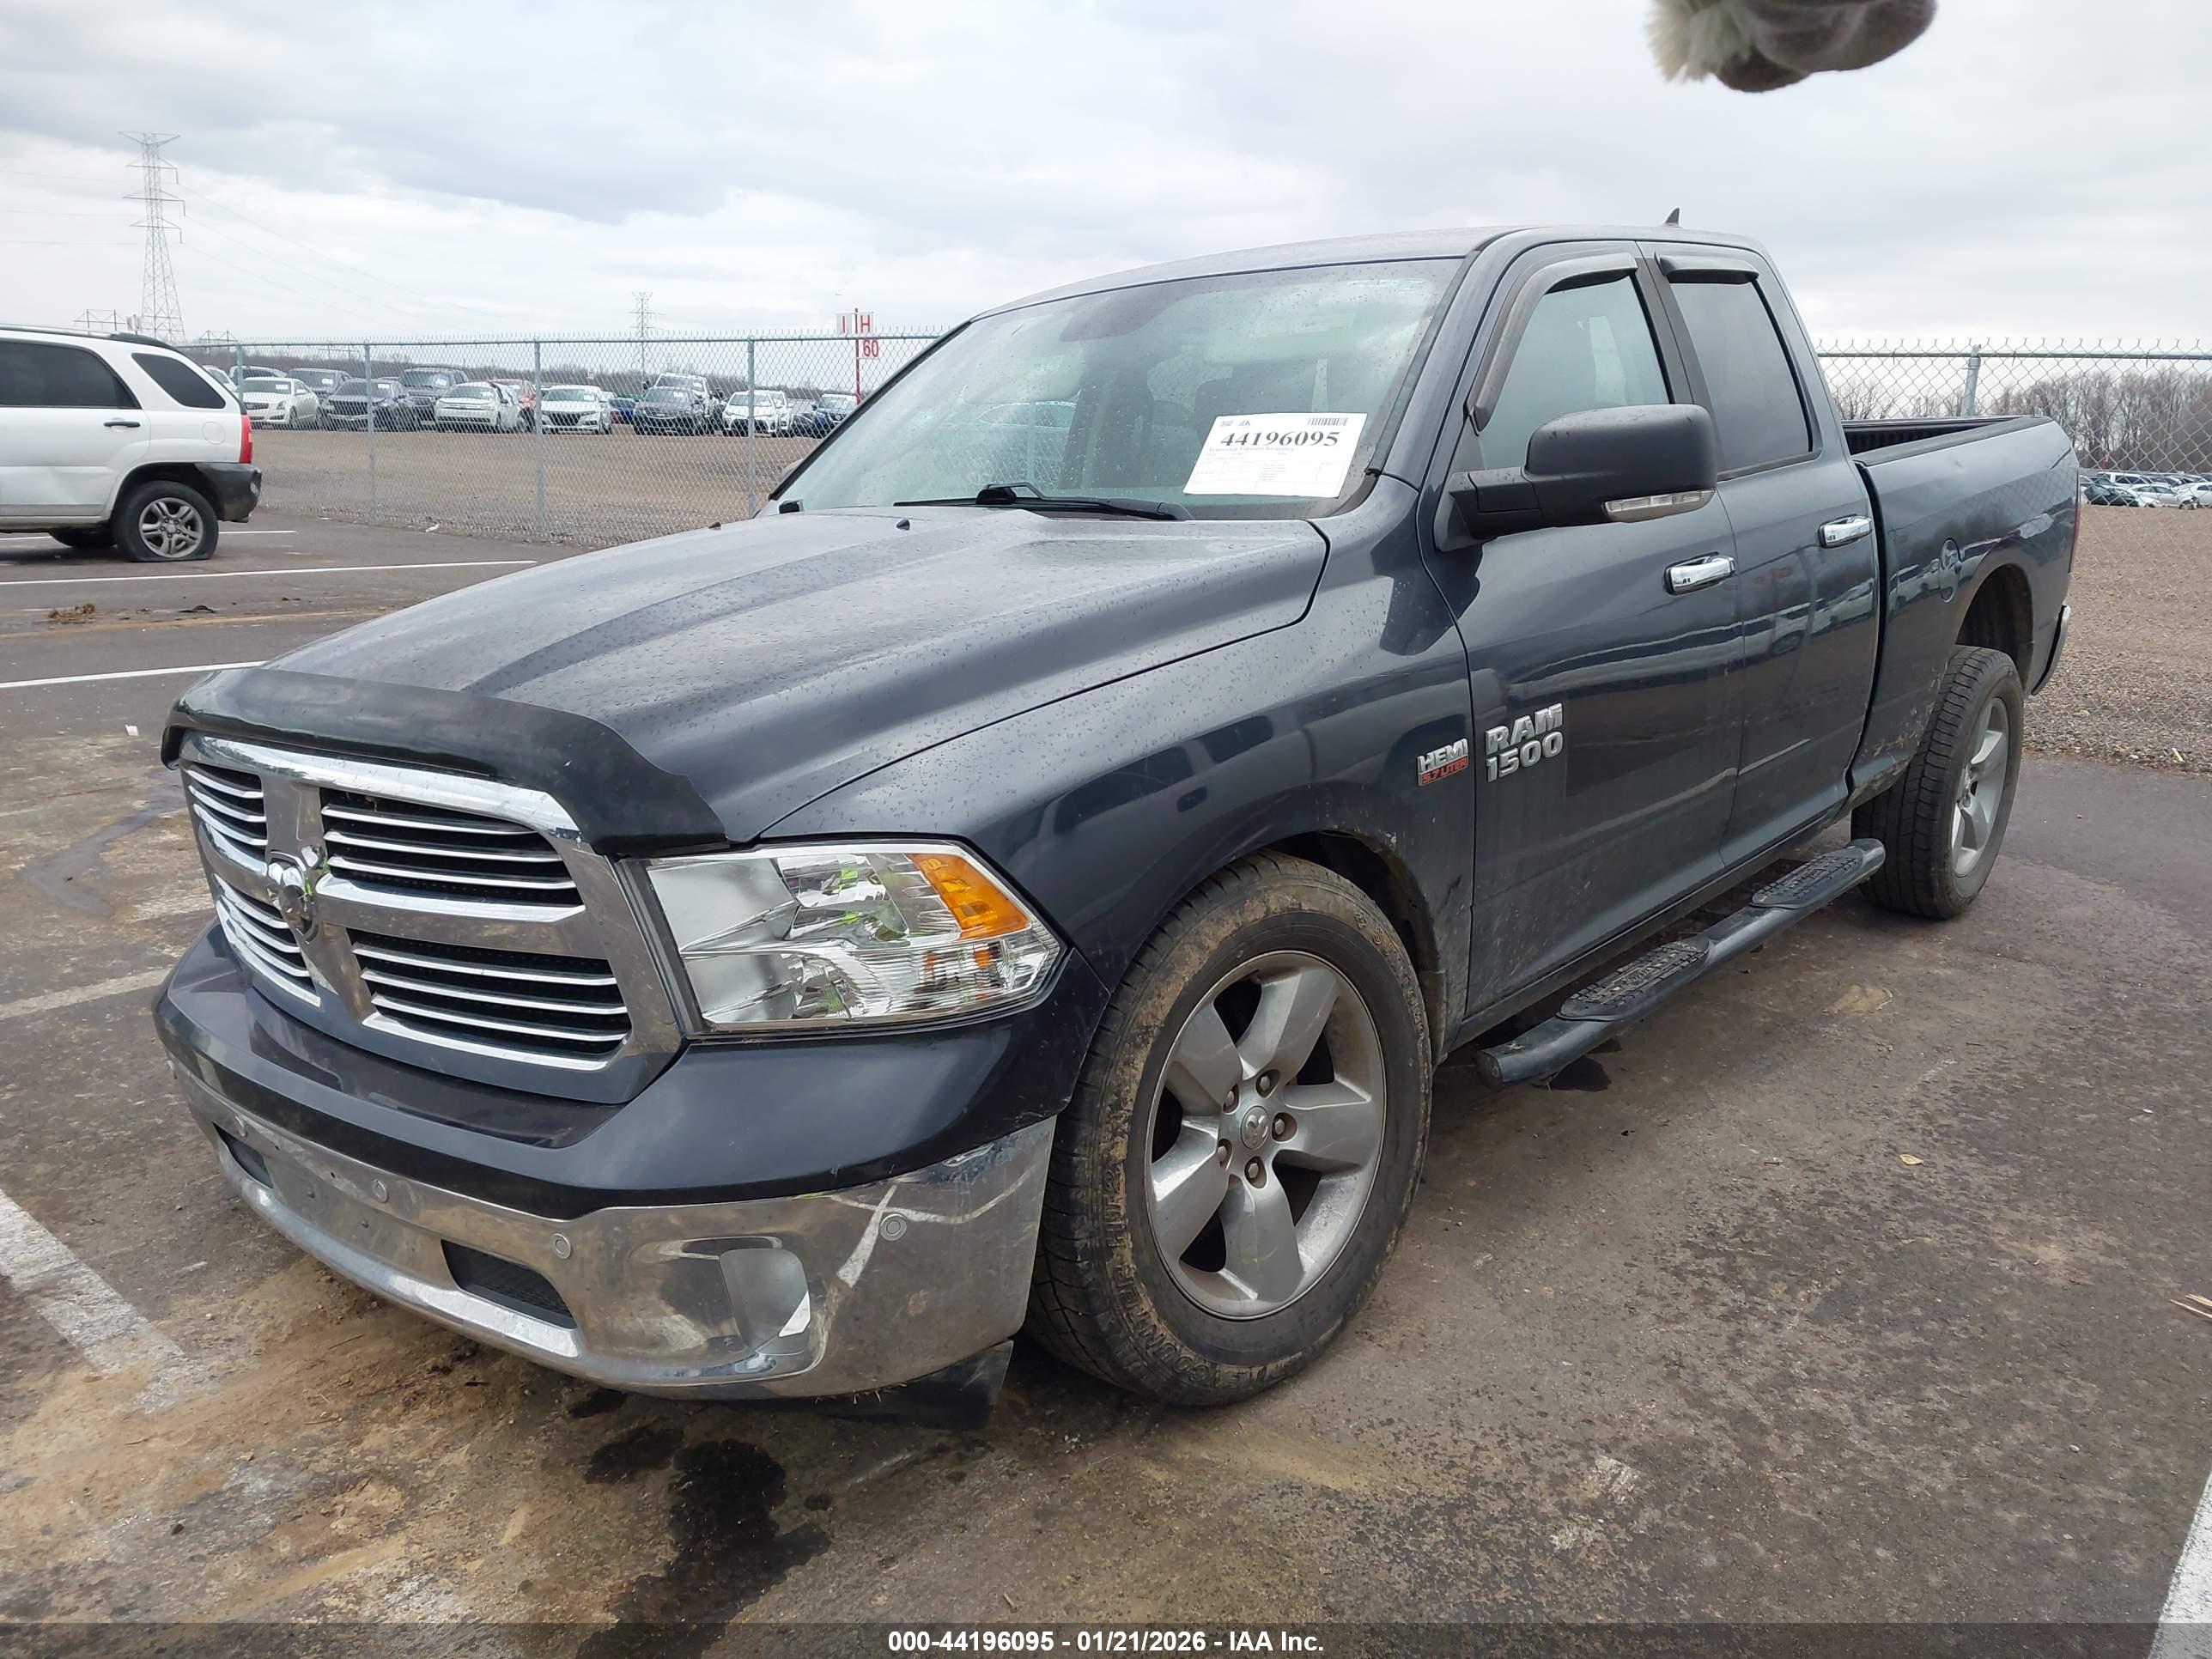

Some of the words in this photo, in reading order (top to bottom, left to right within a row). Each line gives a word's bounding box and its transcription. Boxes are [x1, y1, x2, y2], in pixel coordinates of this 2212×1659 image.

[860, 314, 871, 333] H
[863, 339, 879, 357] 60
[1220, 430, 1340, 447] 44196095
[1486, 702, 1563, 755] RAM
[1418, 738, 1468, 773] HEMI
[1486, 732, 1564, 782] 1500
